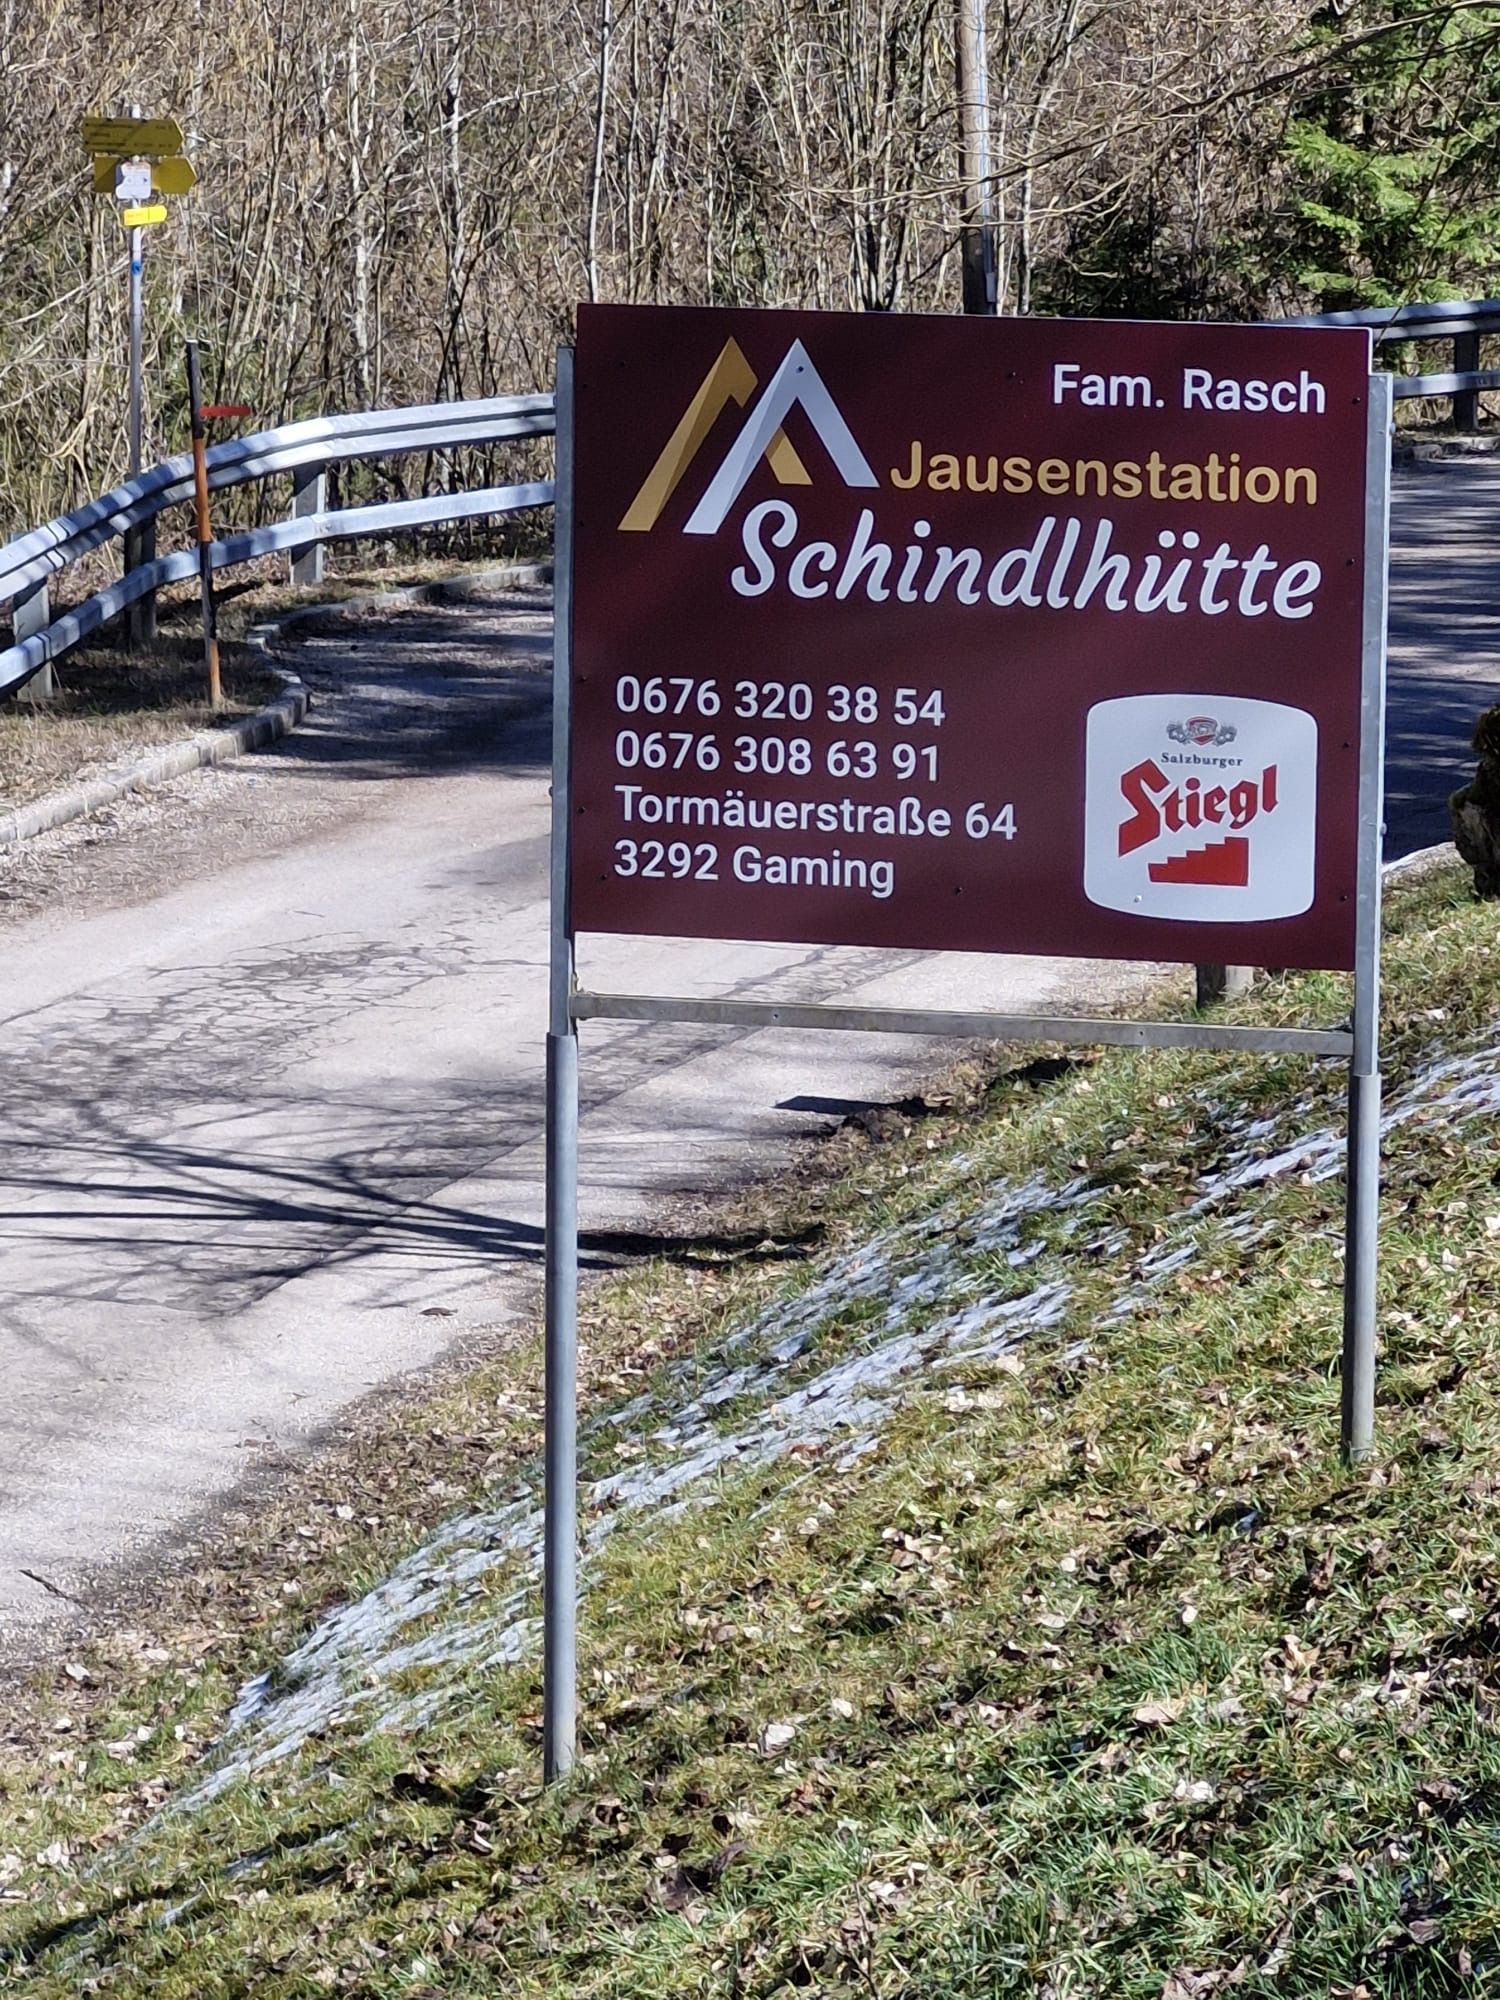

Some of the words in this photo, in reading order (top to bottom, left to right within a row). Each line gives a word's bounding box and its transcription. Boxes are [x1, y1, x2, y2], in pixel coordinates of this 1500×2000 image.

[1053, 363, 1164, 409] Fam.
[1183, 366, 1327, 415] Rasch
[890, 440, 1319, 506] Jausenstation
[730, 498, 1322, 619] Schindlhütte
[615, 675, 721, 717] 0676
[734, 680, 813, 721] 320
[826, 685, 879, 724] 38
[893, 688, 946, 727] 54
[614, 730, 721, 771] 0676
[733, 736, 812, 776] 308
[826, 740, 878, 779] 63
[892, 743, 940, 782] 91
[1160, 751, 1244, 769] Salzburger
[613, 784, 952, 838] Tormäuerstraße
[965, 802, 1018, 841] 64
[1118, 758, 1279, 858] Stiegl
[613, 839, 719, 881] 3292
[732, 845, 896, 900] Gaming
